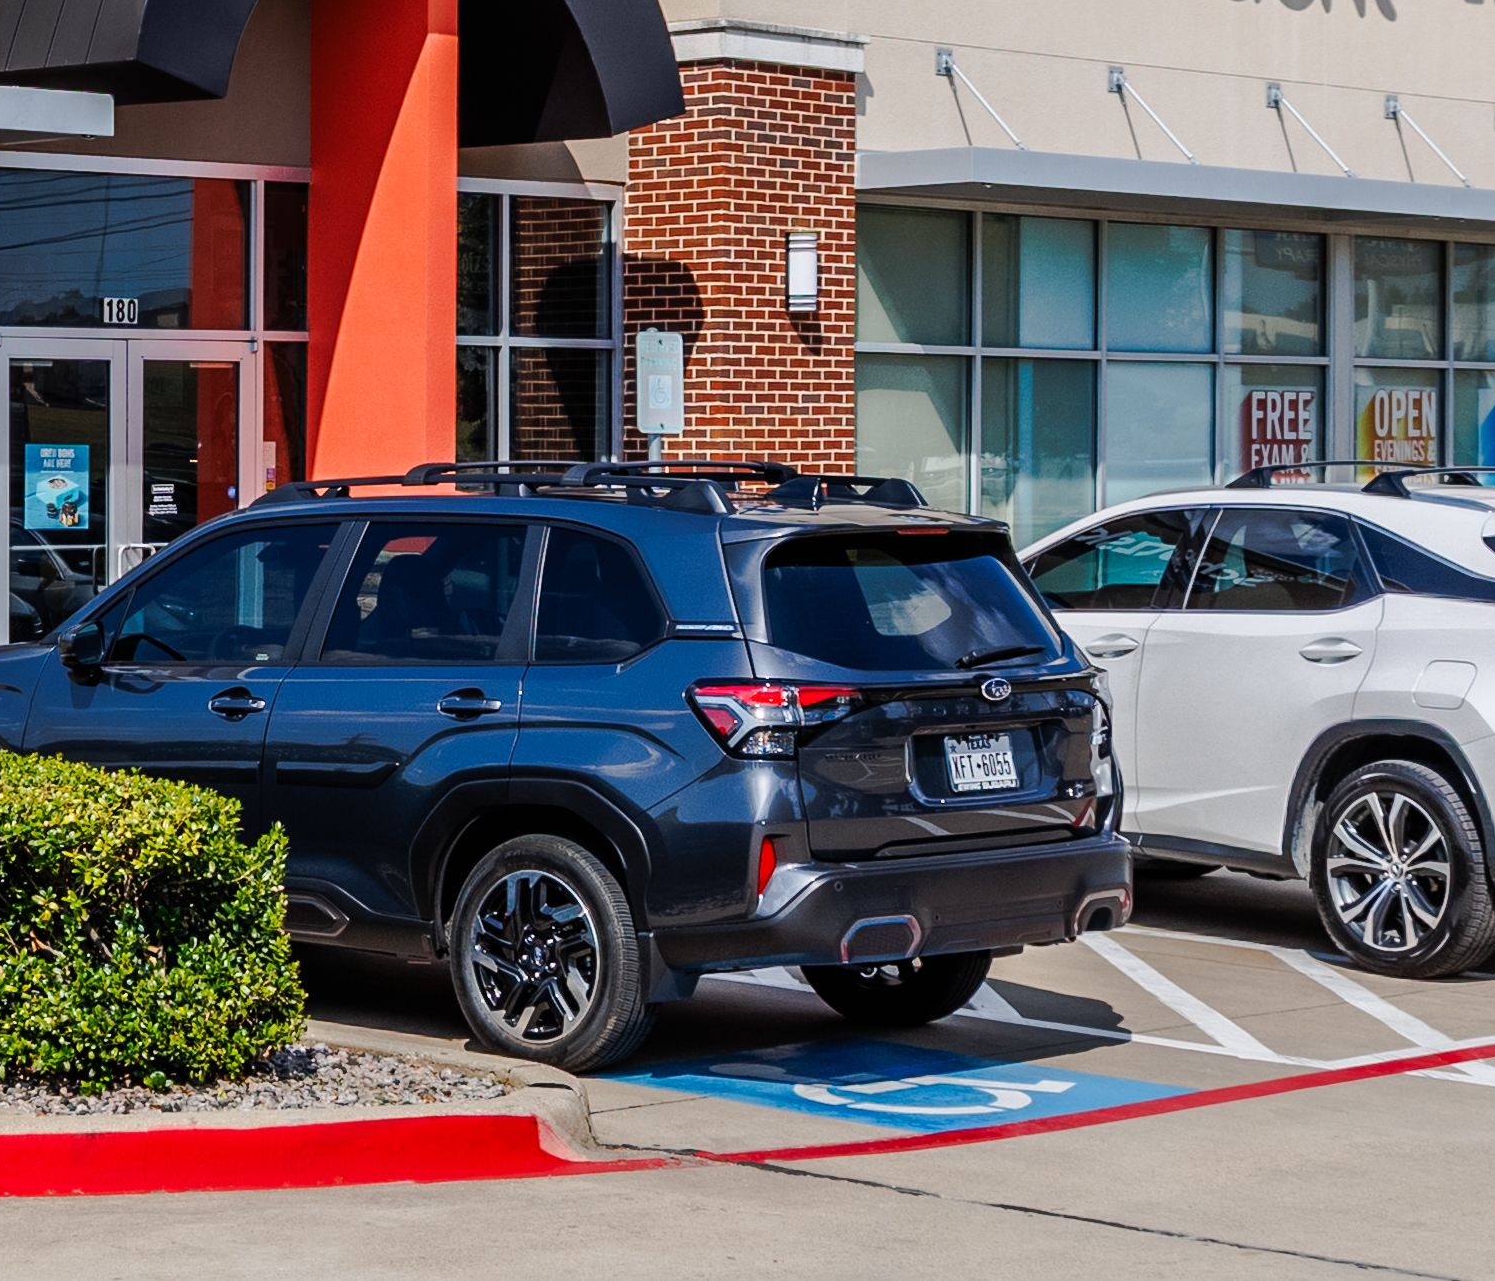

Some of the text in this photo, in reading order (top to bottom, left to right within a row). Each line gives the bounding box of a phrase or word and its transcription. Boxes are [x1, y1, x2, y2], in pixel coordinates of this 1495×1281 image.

[106, 299, 137, 323] 180
[1251, 391, 1313, 440] FREE
[1374, 389, 1437, 437] OPEN
[1251, 443, 1311, 474] EXAM &
[1374, 440, 1425, 462] EVENINGS
[967, 735, 992, 750] TEXAS
